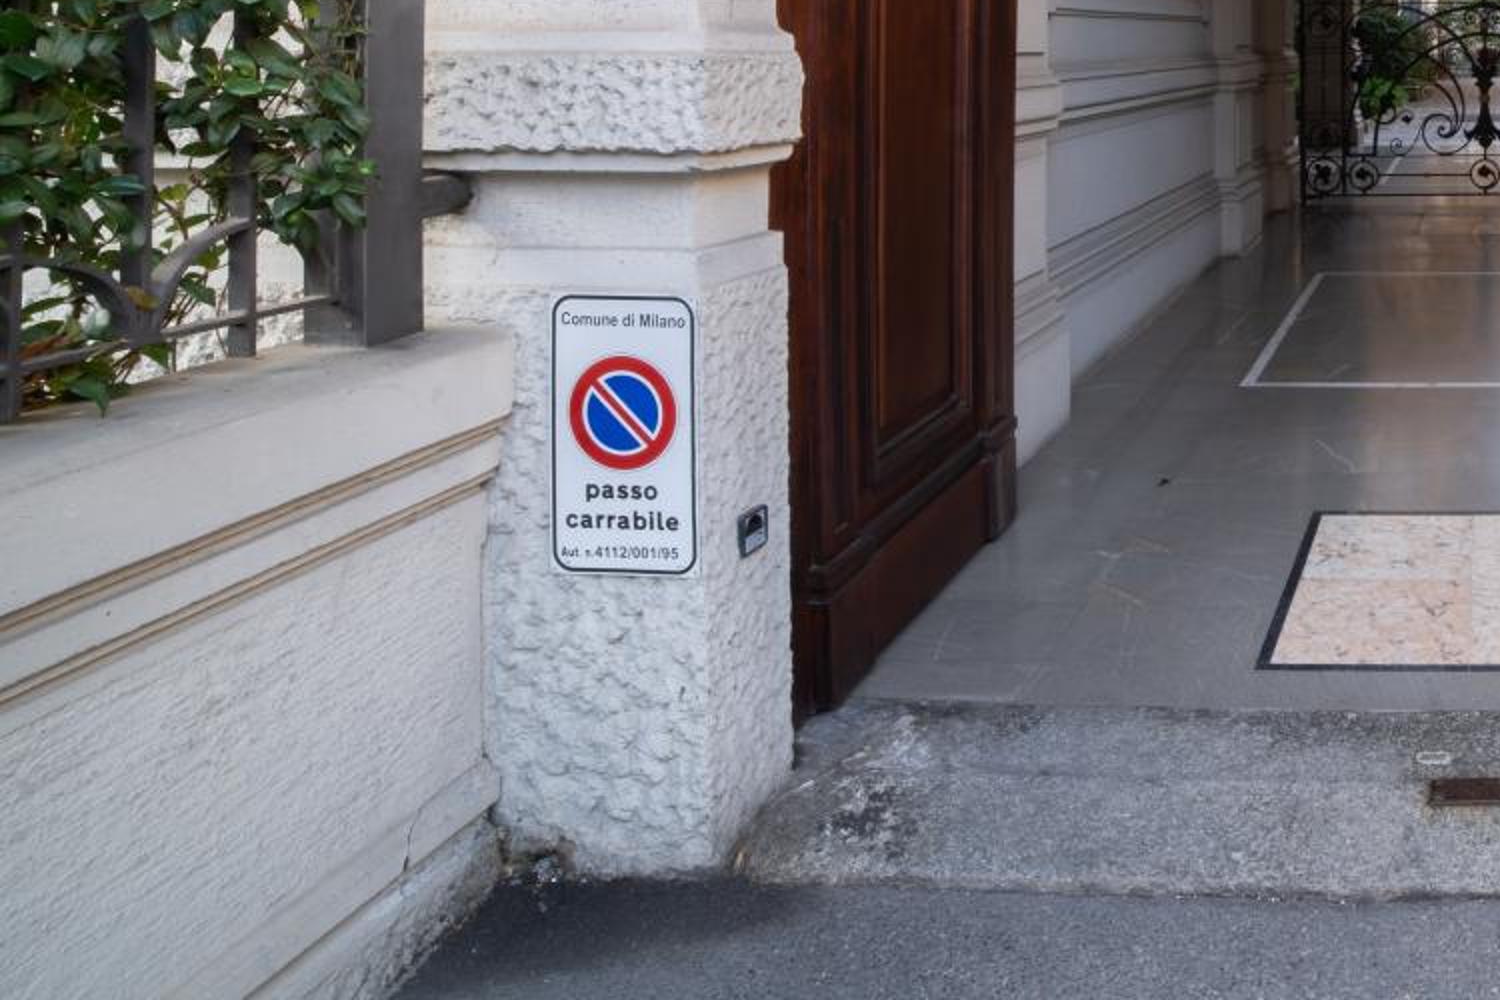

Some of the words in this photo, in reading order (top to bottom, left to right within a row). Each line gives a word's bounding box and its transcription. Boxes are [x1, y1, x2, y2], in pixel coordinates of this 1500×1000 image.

[561, 311, 618, 327] Comune
[622, 313, 635, 328] di
[640, 313, 686, 329] Milano
[585, 483, 658, 502] passo
[565, 510, 680, 531] carrabile
